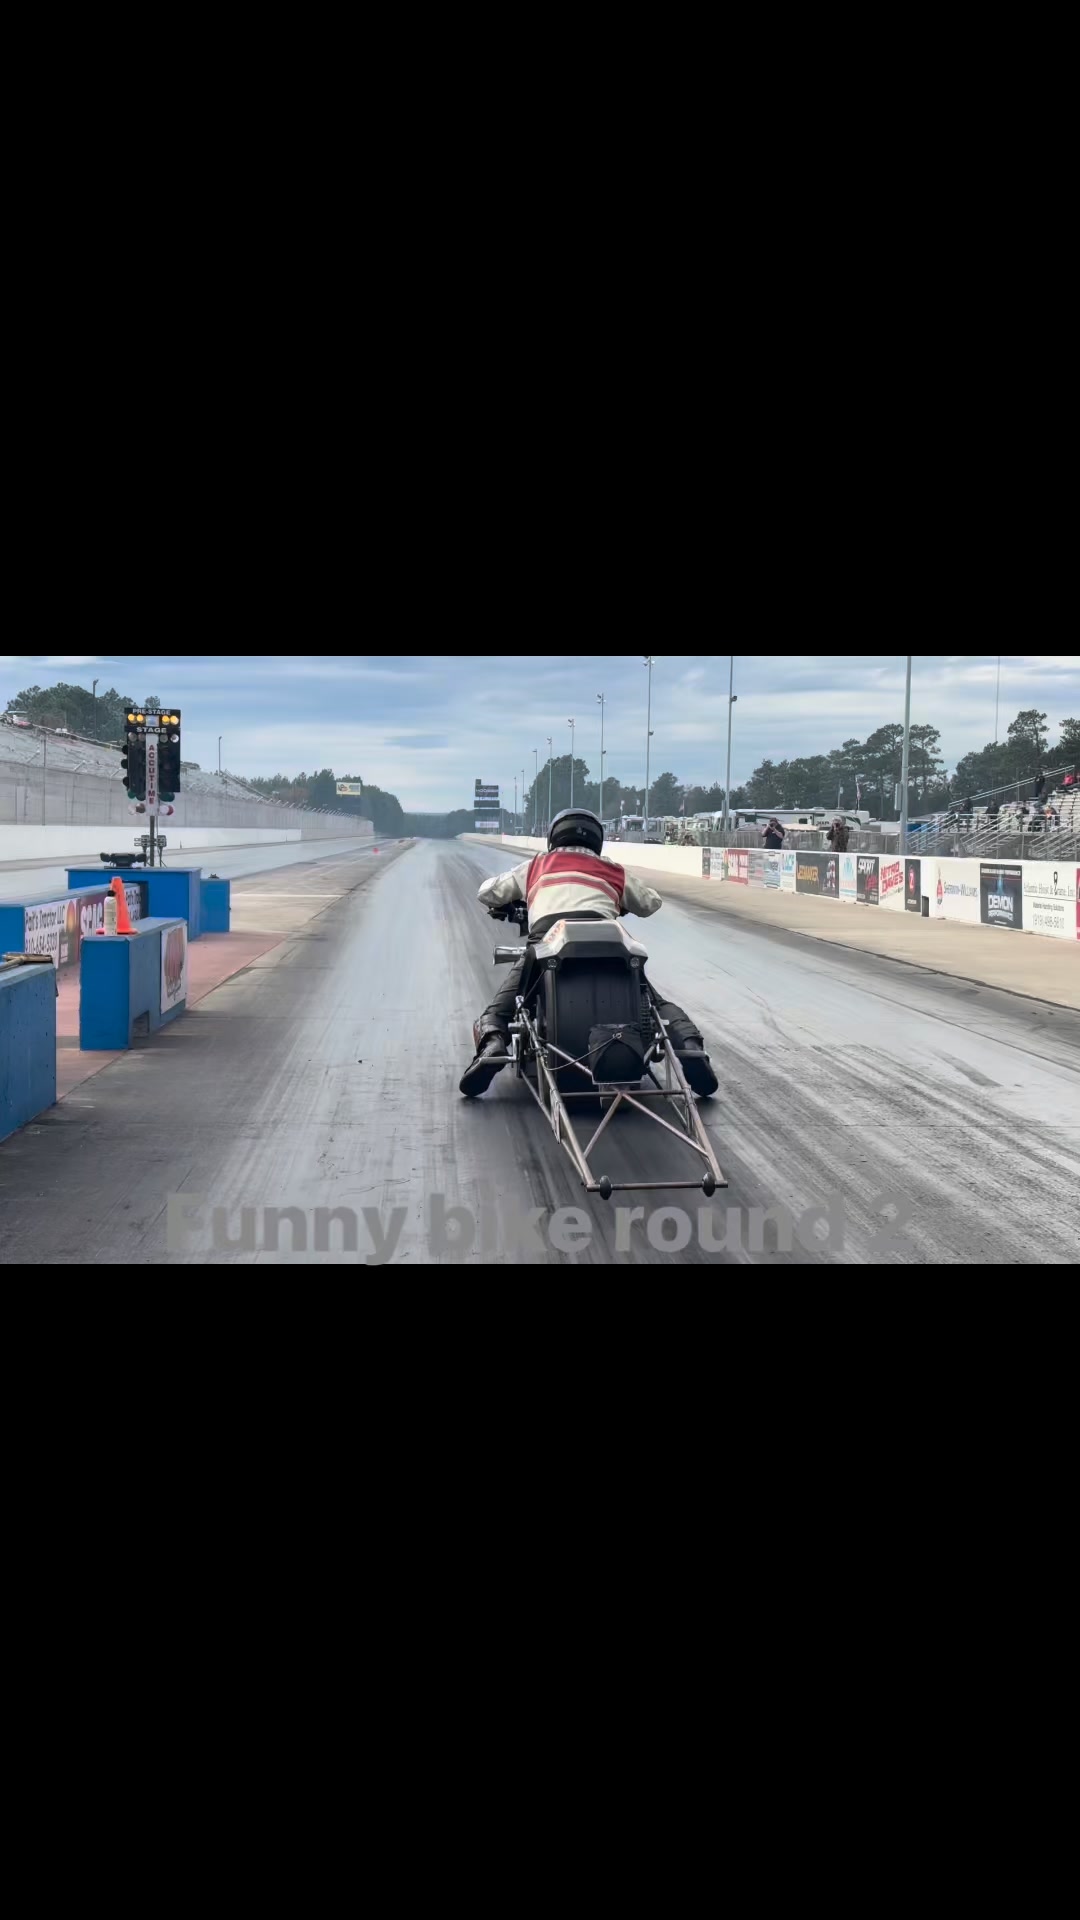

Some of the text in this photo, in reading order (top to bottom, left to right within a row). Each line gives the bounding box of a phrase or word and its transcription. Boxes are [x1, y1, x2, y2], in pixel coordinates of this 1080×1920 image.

[148, 744, 156, 805] ACCUTIME
[880, 860, 900, 881] NITRO
[987, 894, 1014, 912] DEMON
[39, 908, 57, 930] Tractor
[57, 904, 66, 925] LLC
